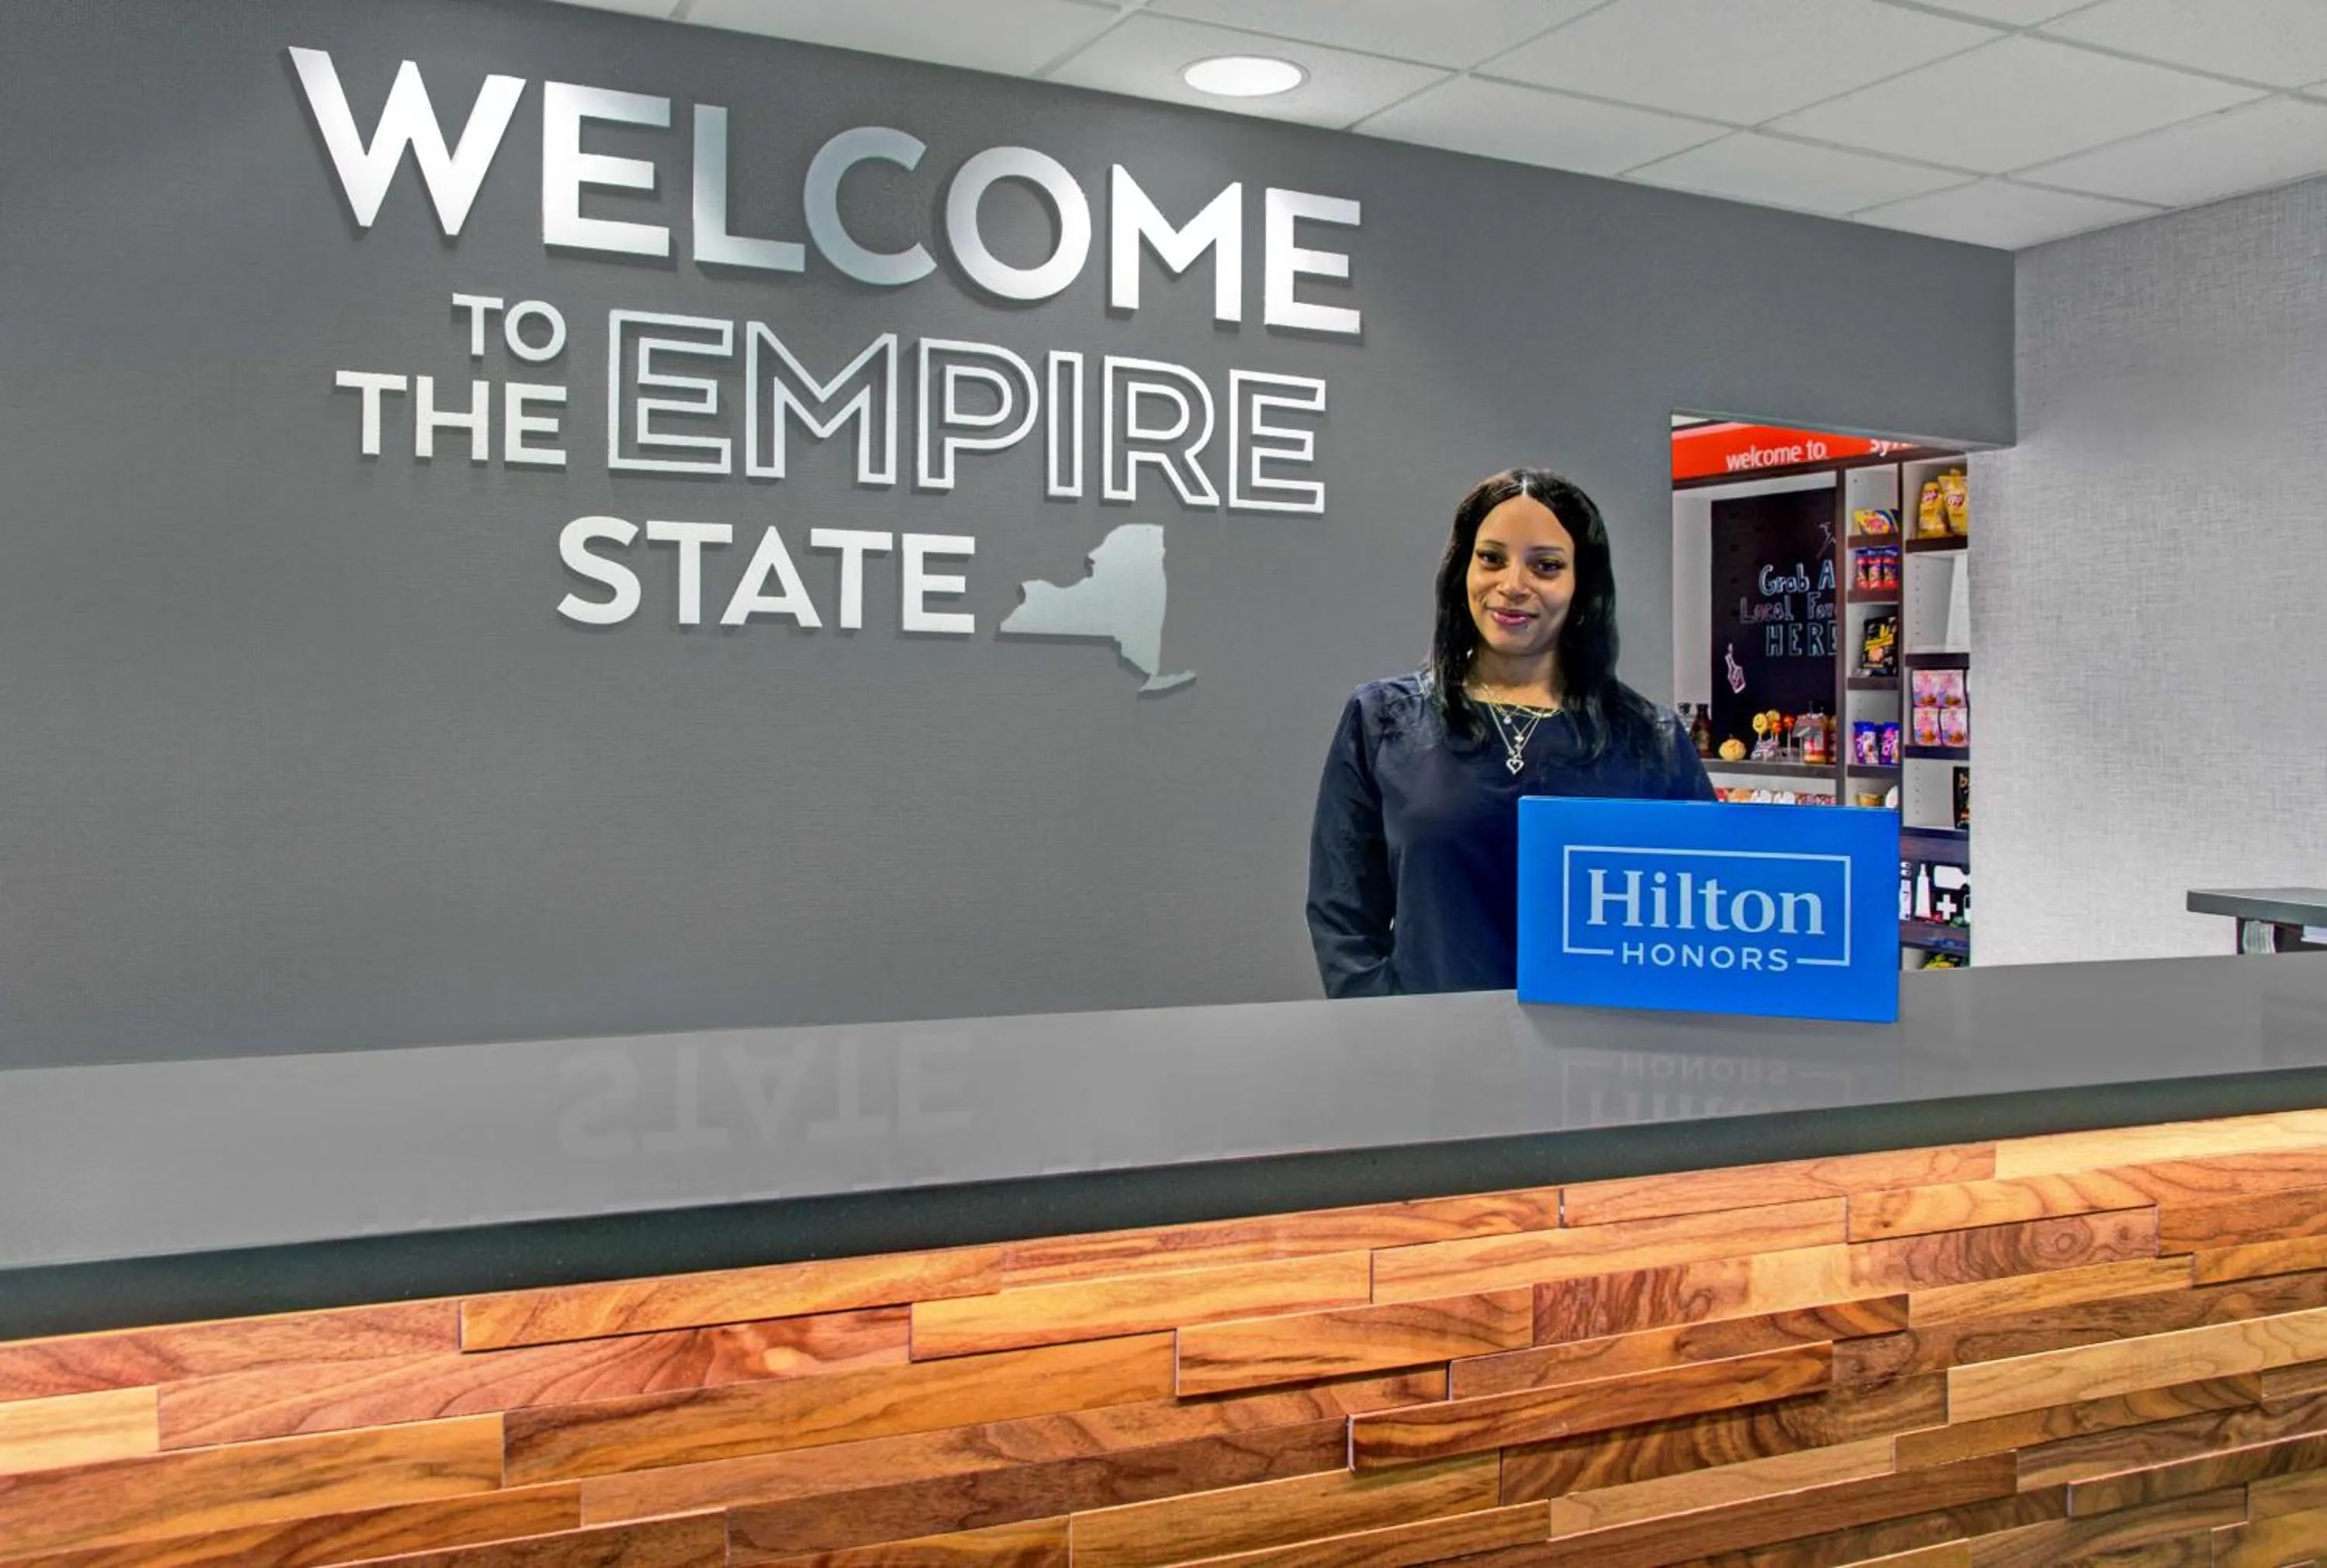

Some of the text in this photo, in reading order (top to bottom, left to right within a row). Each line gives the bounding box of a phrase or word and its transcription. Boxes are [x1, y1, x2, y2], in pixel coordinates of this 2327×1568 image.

[288, 46, 1361, 334] WELCOME
[452, 292, 567, 361] TO
[335, 370, 567, 465] THE
[607, 309, 1326, 514] EMPIRE
[1725, 444, 1801, 471] welcome
[1806, 439, 1827, 459] to
[557, 515, 976, 634] STATE
[1740, 592, 1838, 623] Local Fav
[1758, 558, 1836, 596] Grab A
[1765, 621, 1838, 657] HERE
[1585, 869, 1826, 935] Hilton
[1621, 942, 1789, 972] HONORS
